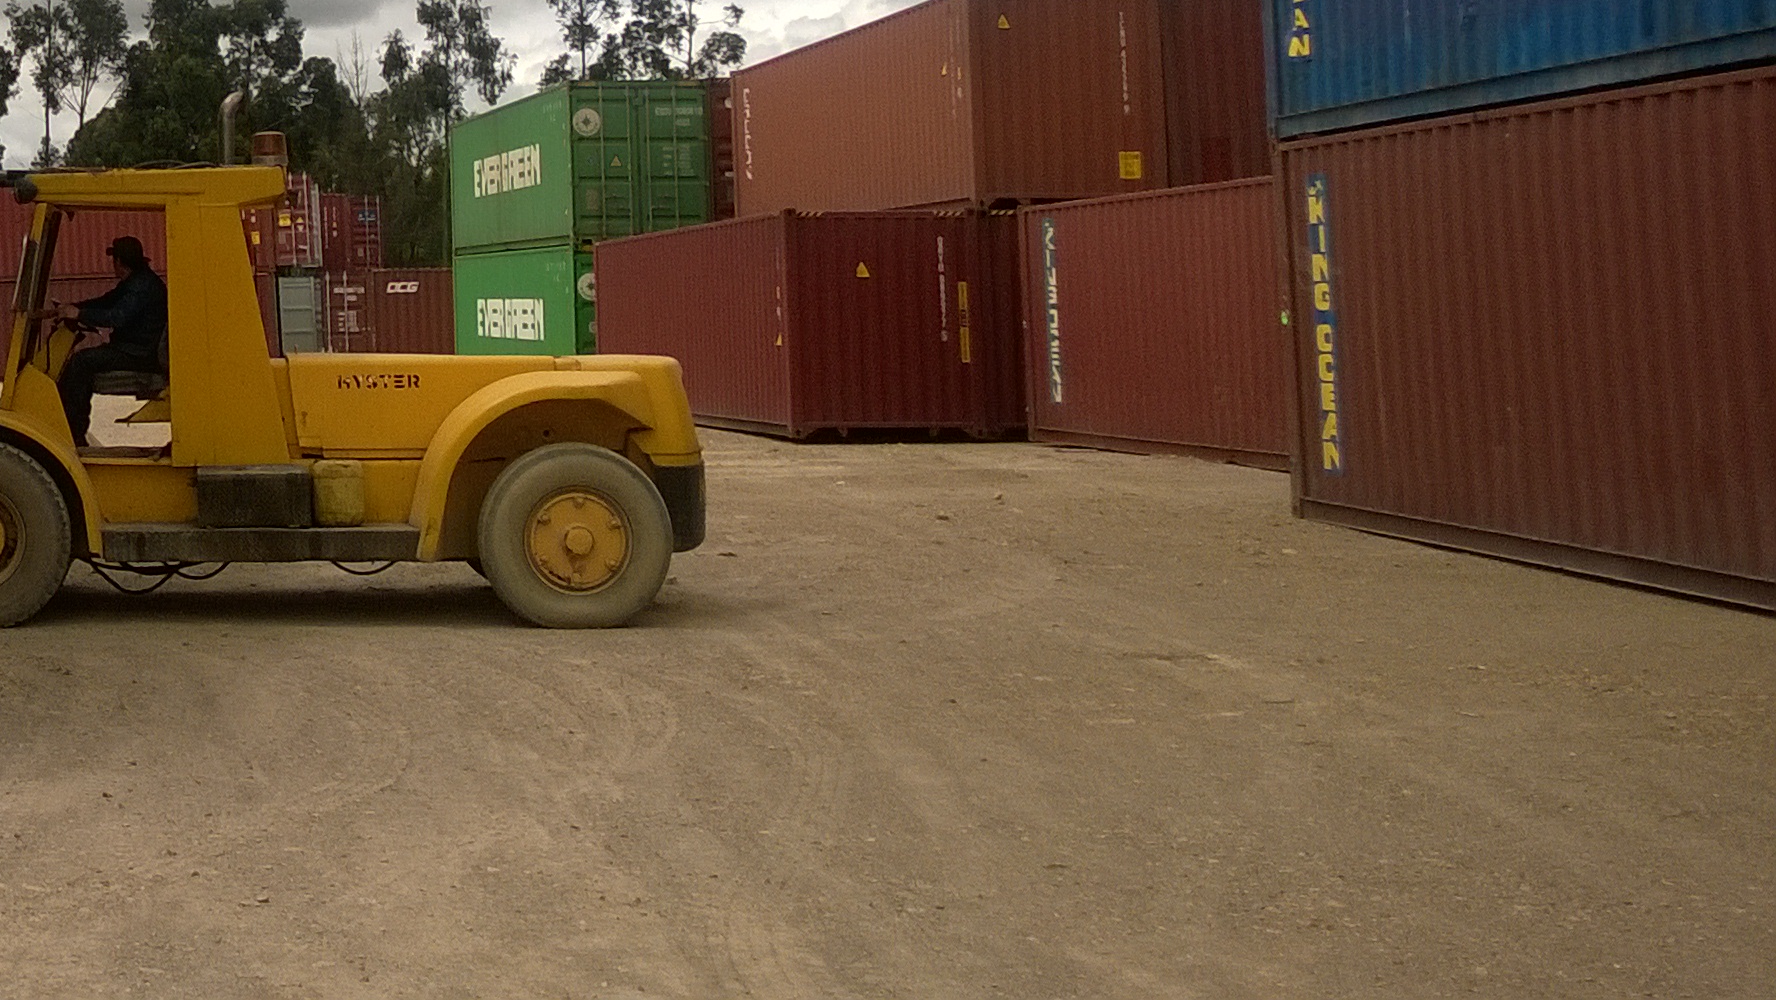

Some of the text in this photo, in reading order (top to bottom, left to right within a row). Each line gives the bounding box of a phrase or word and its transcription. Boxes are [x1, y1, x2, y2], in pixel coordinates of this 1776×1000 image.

[474, 143, 542, 198] EVERGREEN
[477, 297, 544, 341] EVERGREEN
[1307, 196, 1341, 471] KING OCEAN
